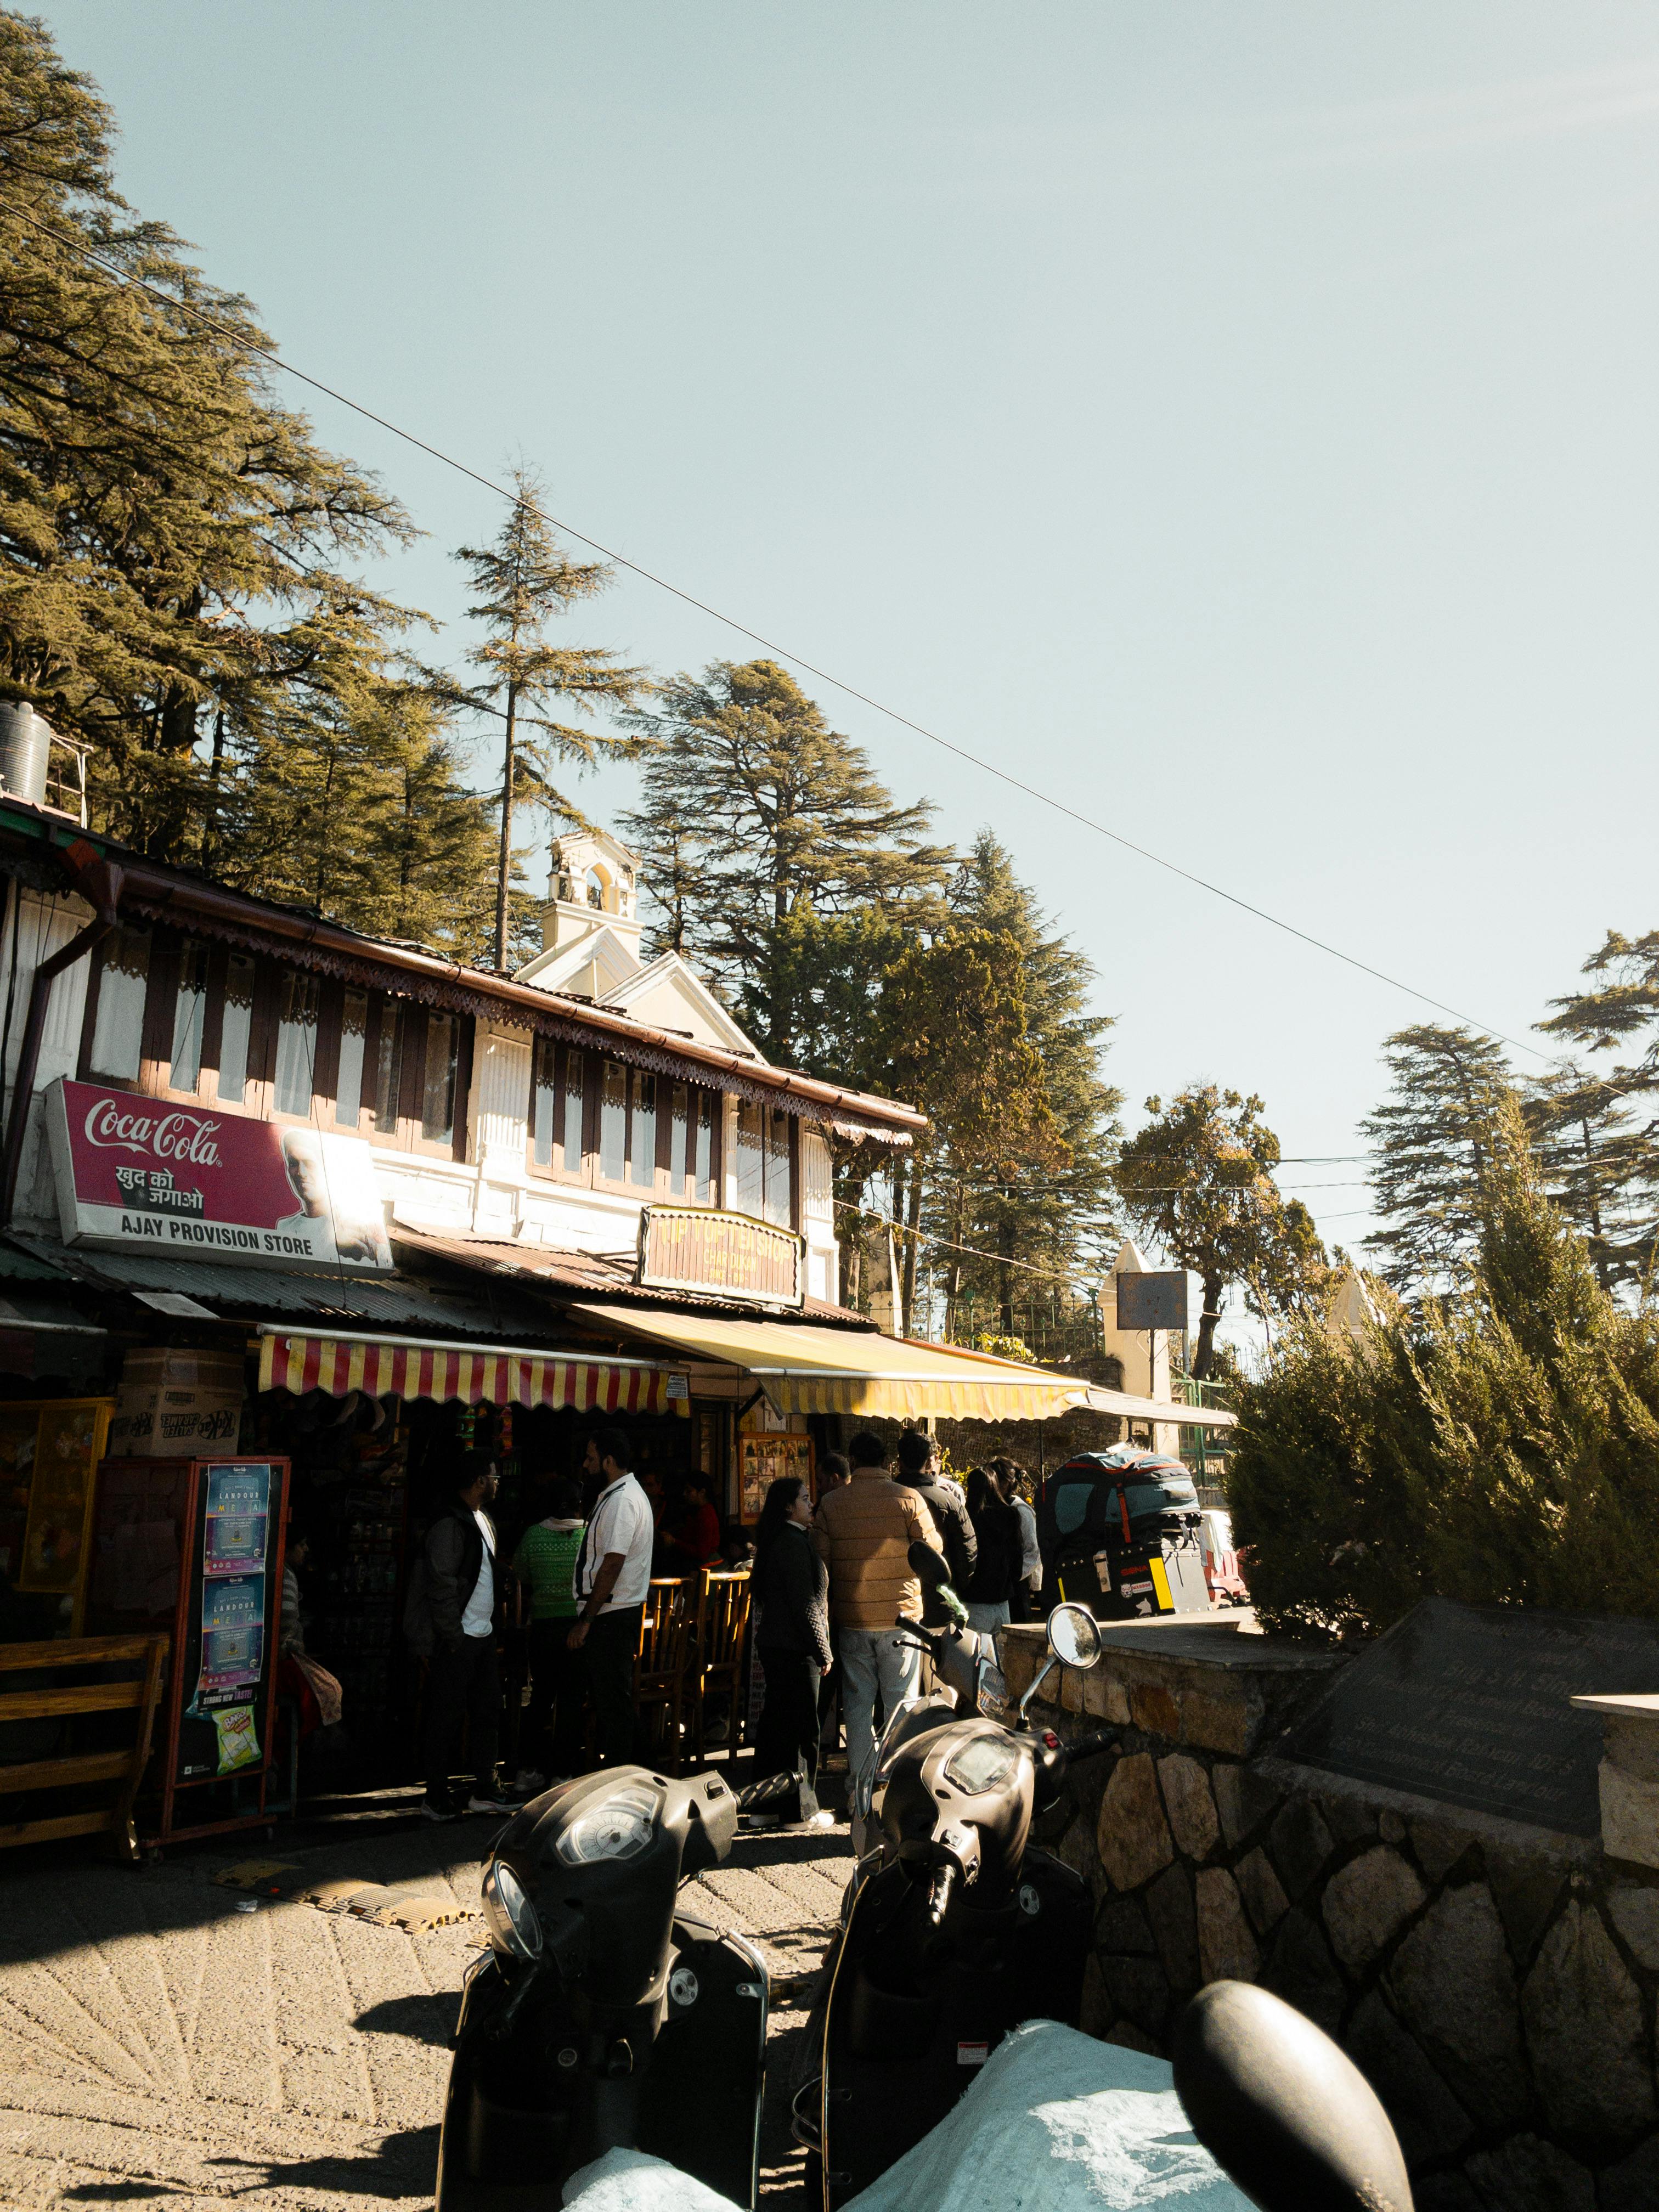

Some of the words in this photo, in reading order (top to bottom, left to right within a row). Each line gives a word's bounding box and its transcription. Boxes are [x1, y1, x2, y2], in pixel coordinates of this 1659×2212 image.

[85, 1099, 221, 1166] Coca-Cola
[115, 1166, 146, 1189] खुद
[150, 1167, 174, 1189] को
[149, 1187, 204, 1209] जगाओ
[121, 1215, 163, 1236] AJAY
[170, 1223, 259, 1249] PROVISION
[264, 1234, 313, 1256] STORE
[658, 1218, 688, 1245] TIP
[692, 1218, 726, 1244] TOP
[727, 1224, 754, 1251] TEA
[757, 1234, 792, 1265] SHOP
[703, 1248, 727, 1267] CHAR
[730, 1252, 757, 1273] DUKAN
[161, 1414, 200, 1426] CARAMEL
[164, 1426, 193, 1438] SALTED
[213, 1601, 255, 1612] LANDOUR
[203, 1694, 222, 1705] STRONG
[234, 1689, 252, 1700] TASTE!
